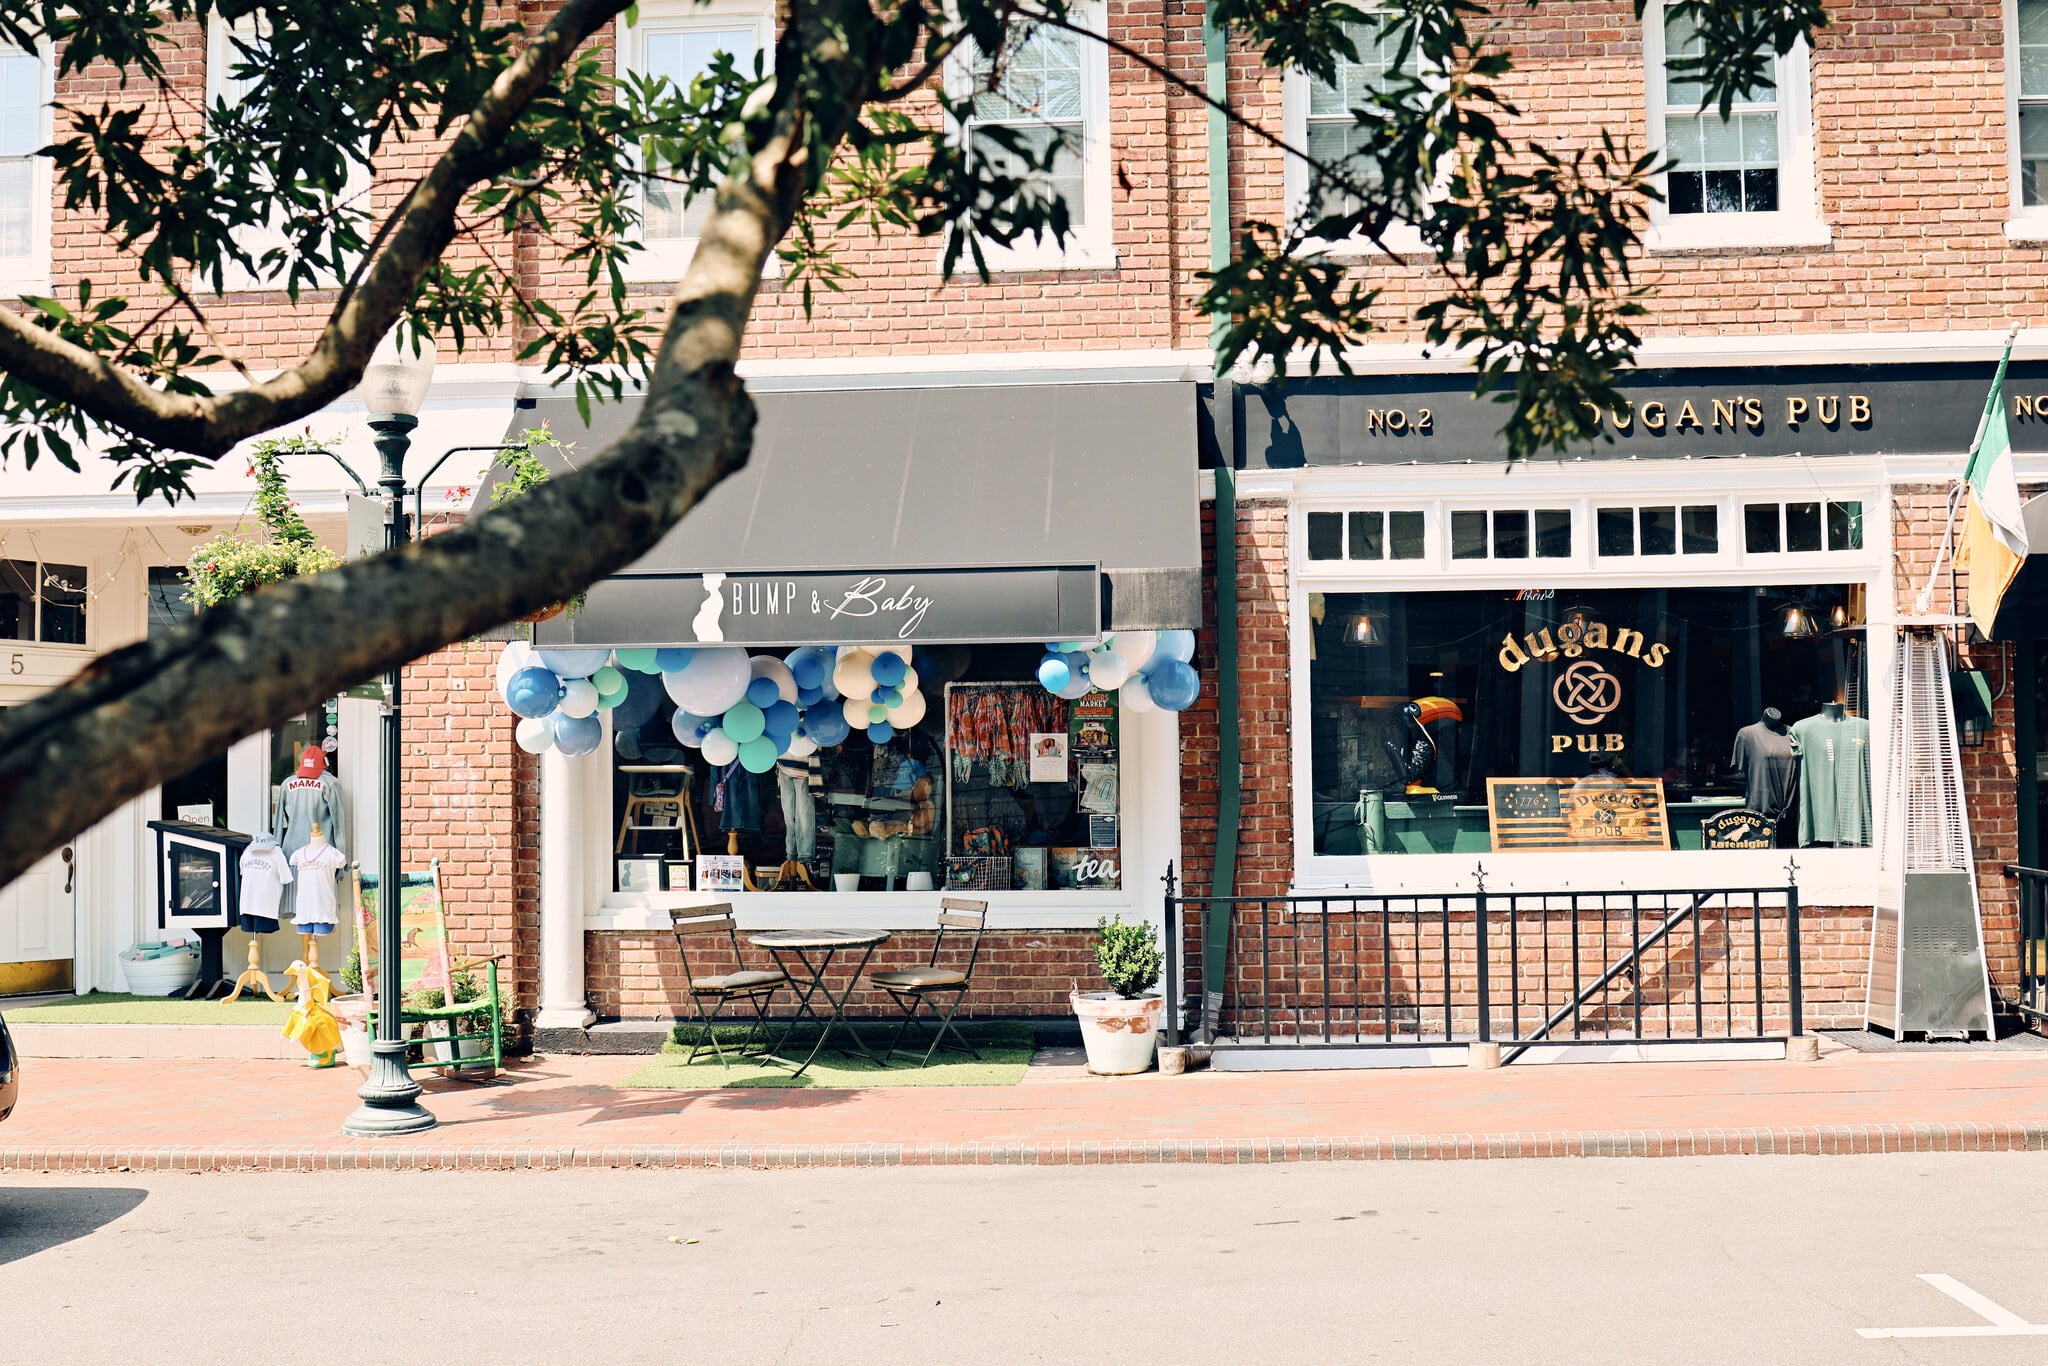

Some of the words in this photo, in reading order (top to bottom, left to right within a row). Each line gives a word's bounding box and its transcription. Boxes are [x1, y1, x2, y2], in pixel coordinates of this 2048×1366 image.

[1367, 408, 1432, 431] NO.2
[1786, 395, 1872, 425] PUB
[732, 582, 796, 615] BUMP
[811, 589, 821, 614] &
[823, 577, 934, 638] Baby
[1498, 621, 1671, 672] dugans
[11, 653, 24, 675] 5
[1080, 700, 1107, 708] MARKET
[1551, 733, 1625, 753] PUB
[289, 780, 321, 790] MAMA
[1514, 797, 1539, 806] 1776
[1576, 792, 1641, 810] Dugan's
[1594, 825, 1623, 837] PUB
[1718, 815, 1762, 830] dugans
[1072, 854, 1120, 882] tea
